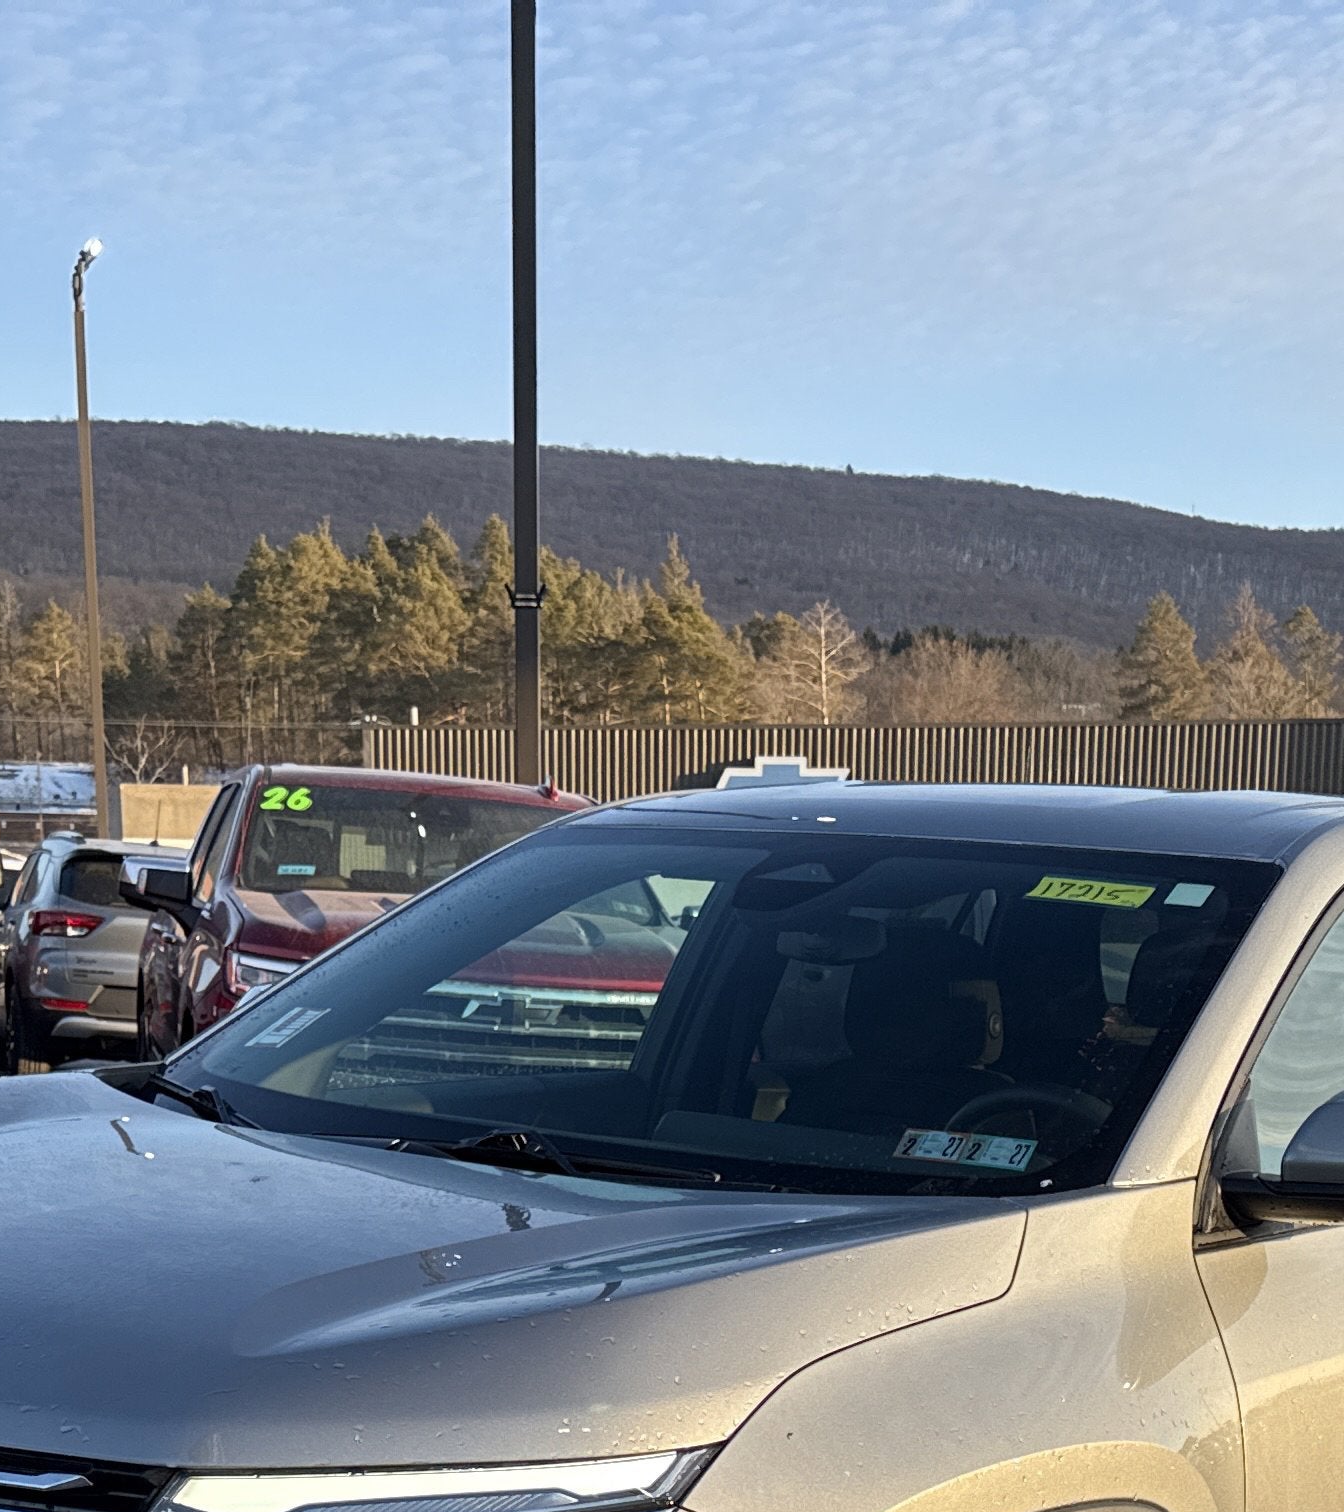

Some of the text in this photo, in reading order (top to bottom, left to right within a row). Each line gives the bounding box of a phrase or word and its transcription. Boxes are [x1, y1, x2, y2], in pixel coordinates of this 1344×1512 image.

[260, 786, 313, 811] 26
[901, 1136, 964, 1159] 2 27
[965, 1142, 1032, 1166] 2 27
